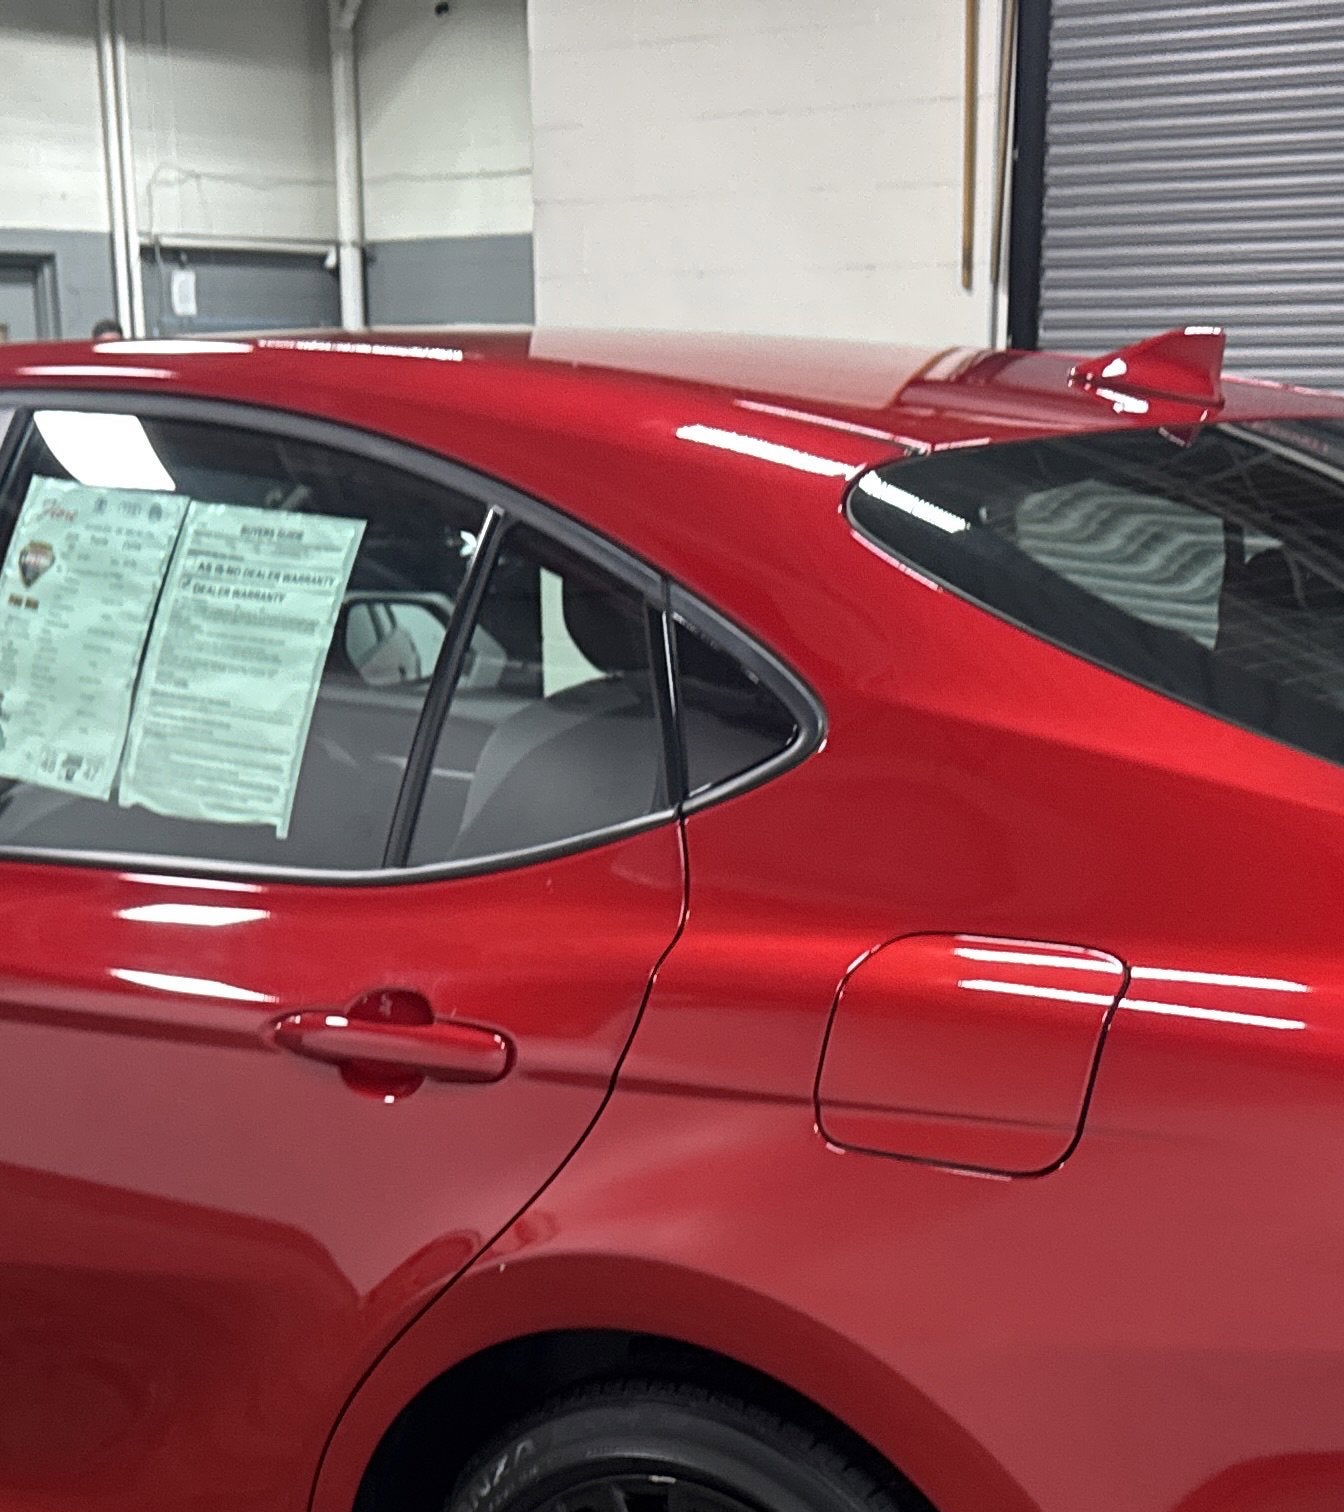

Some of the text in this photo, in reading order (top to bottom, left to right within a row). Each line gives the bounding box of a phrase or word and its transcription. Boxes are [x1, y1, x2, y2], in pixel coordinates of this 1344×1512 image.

[243, 566, 281, 581] DEALER
[282, 571, 336, 586] WARRANTY
[192, 583, 287, 603] DEALER WARRANTY
